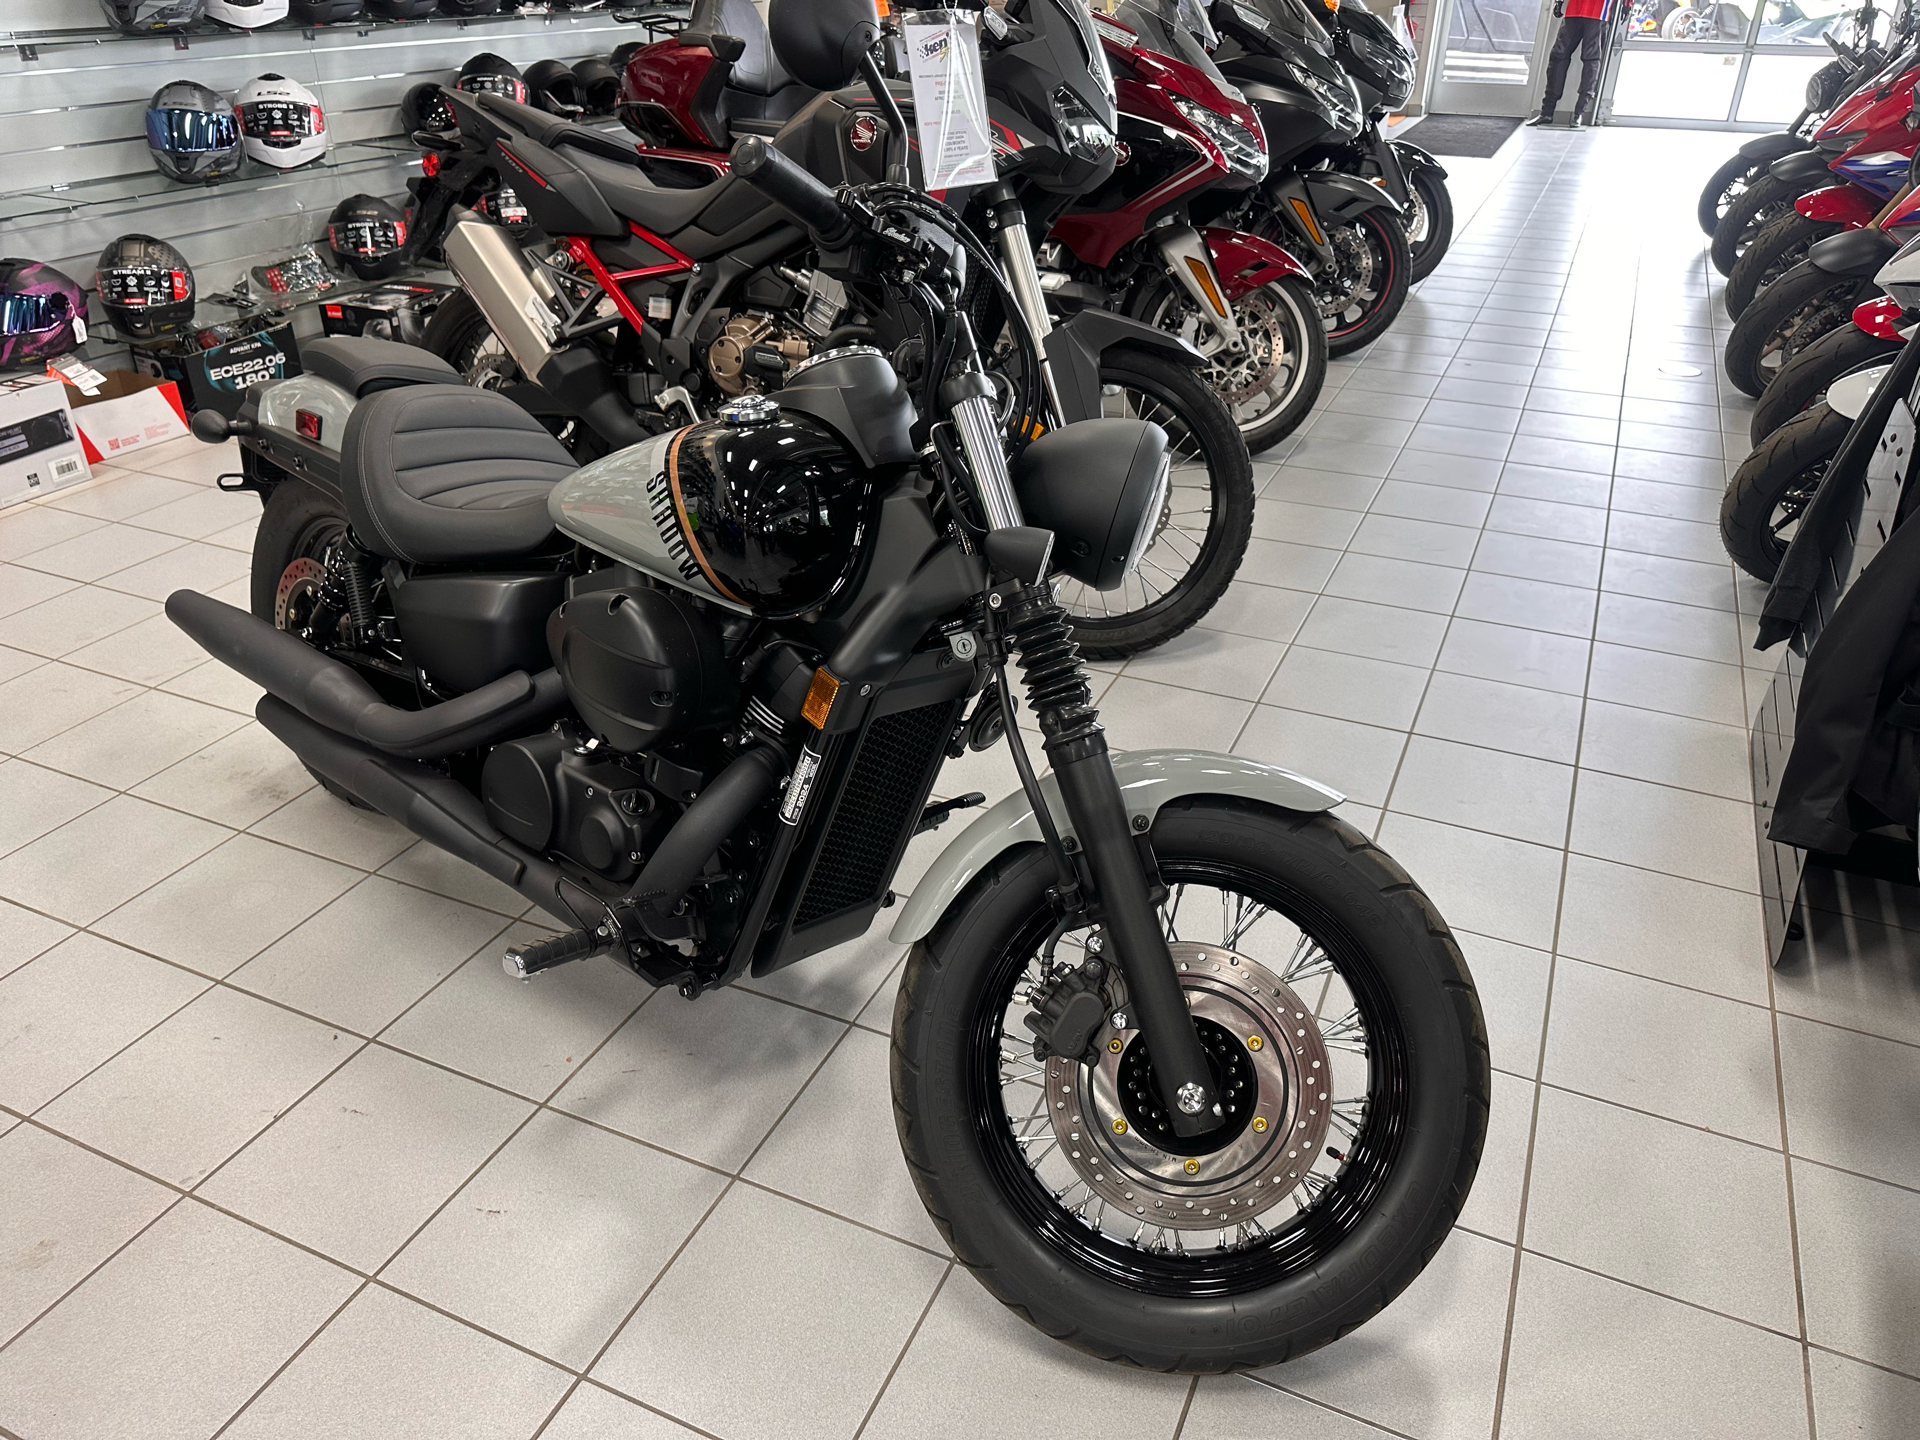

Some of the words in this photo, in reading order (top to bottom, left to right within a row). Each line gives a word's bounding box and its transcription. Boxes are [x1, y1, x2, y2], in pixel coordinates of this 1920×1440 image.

[500, 151, 524, 174] 1100
[229, 345, 251, 355] ADVANT
[209, 351, 287, 381] ECE22.06
[234, 366, 276, 390] 180°
[646, 470, 702, 581] SHADOW
[796, 784, 810, 808] 2024
[935, 1001, 989, 1207] BRIDGESTONE
[1162, 1153, 1178, 1164] MIN
